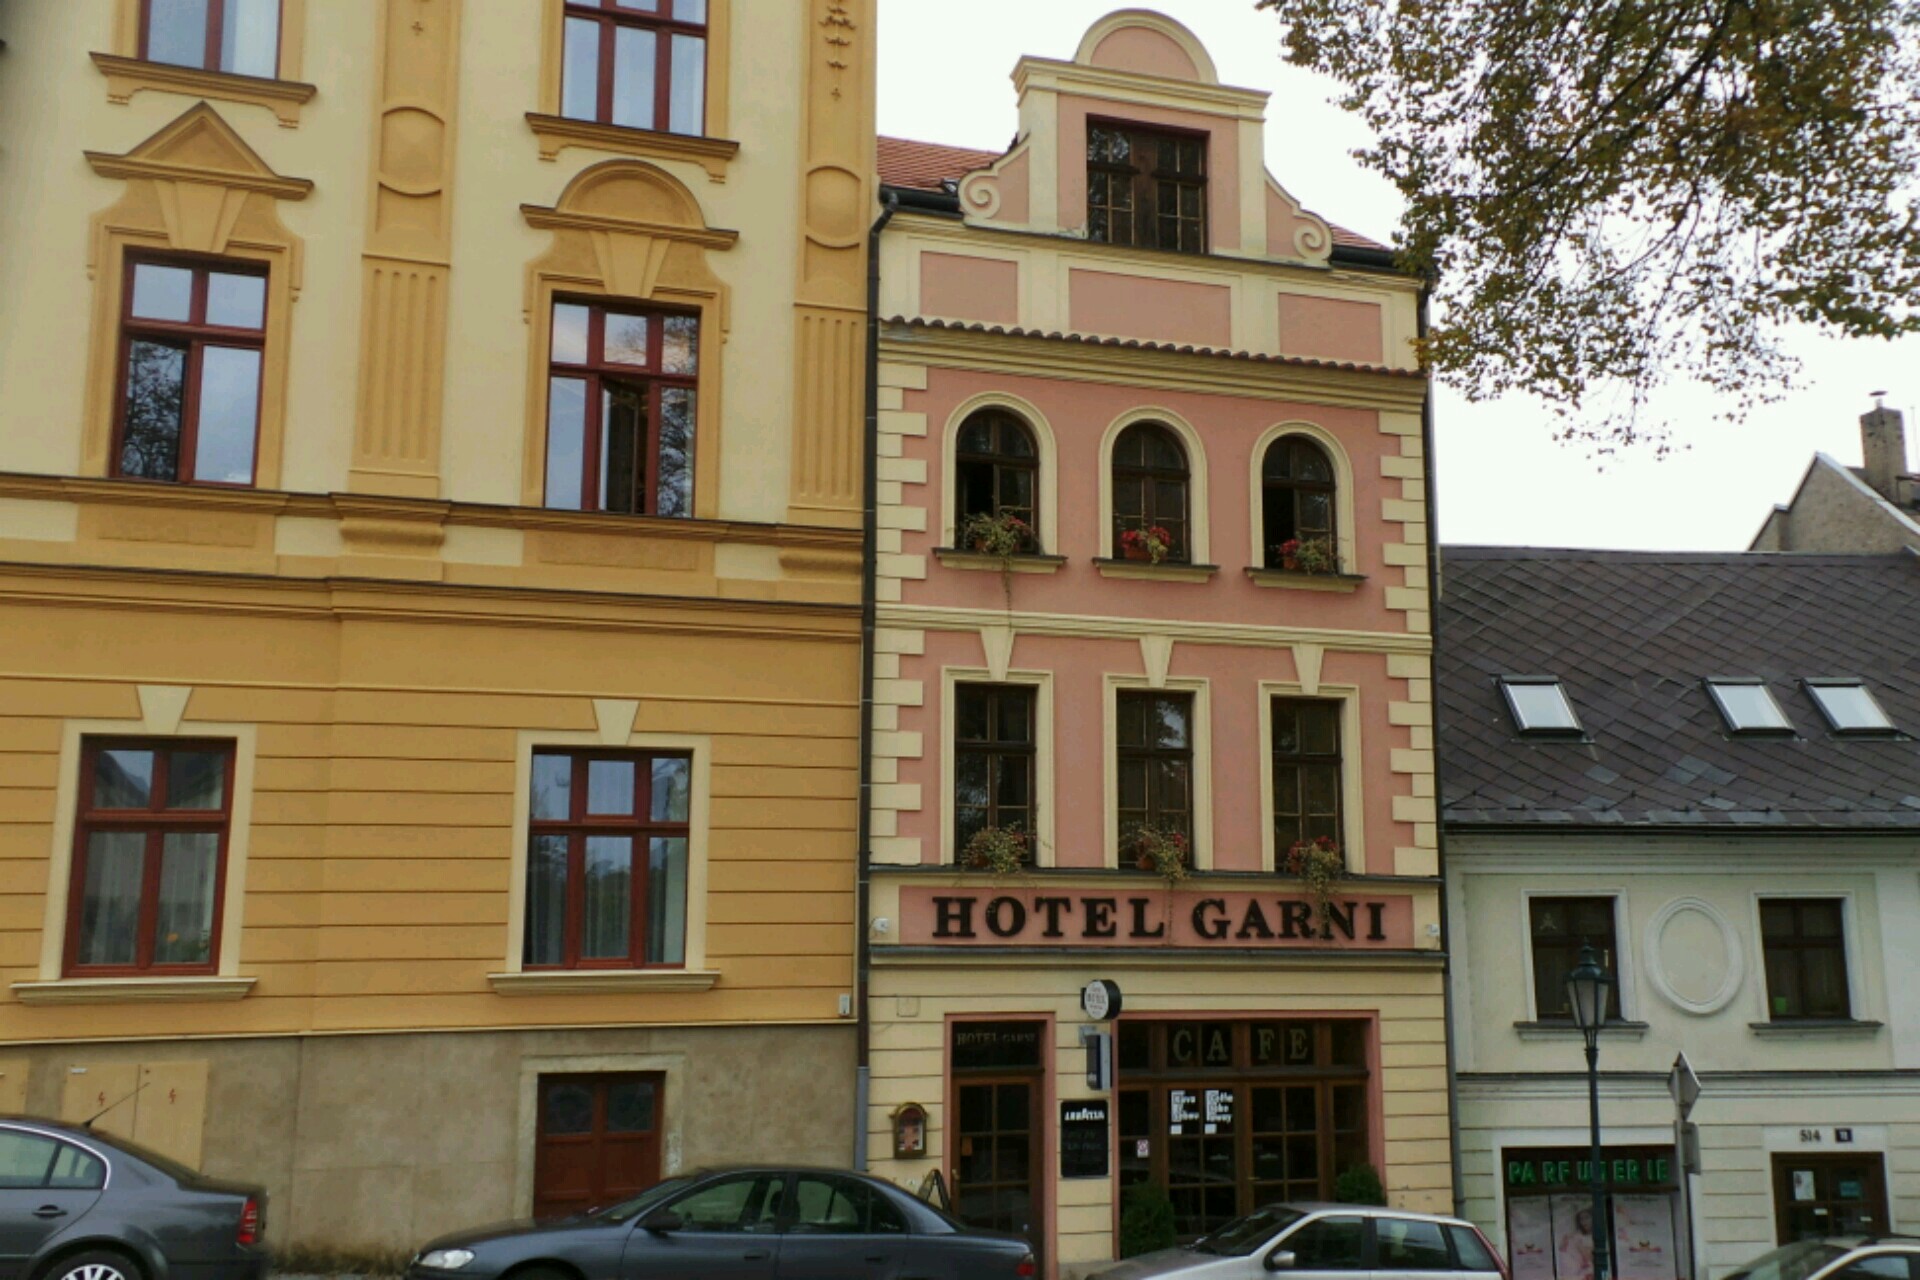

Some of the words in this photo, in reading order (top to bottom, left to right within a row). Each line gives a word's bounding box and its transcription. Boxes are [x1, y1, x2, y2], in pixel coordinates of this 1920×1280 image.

[932, 897, 1165, 938] HOTEL
[1192, 899, 1388, 941] GARNI
[1173, 1028, 1308, 1062] CAFE
[1800, 1129, 1821, 1142] 514
